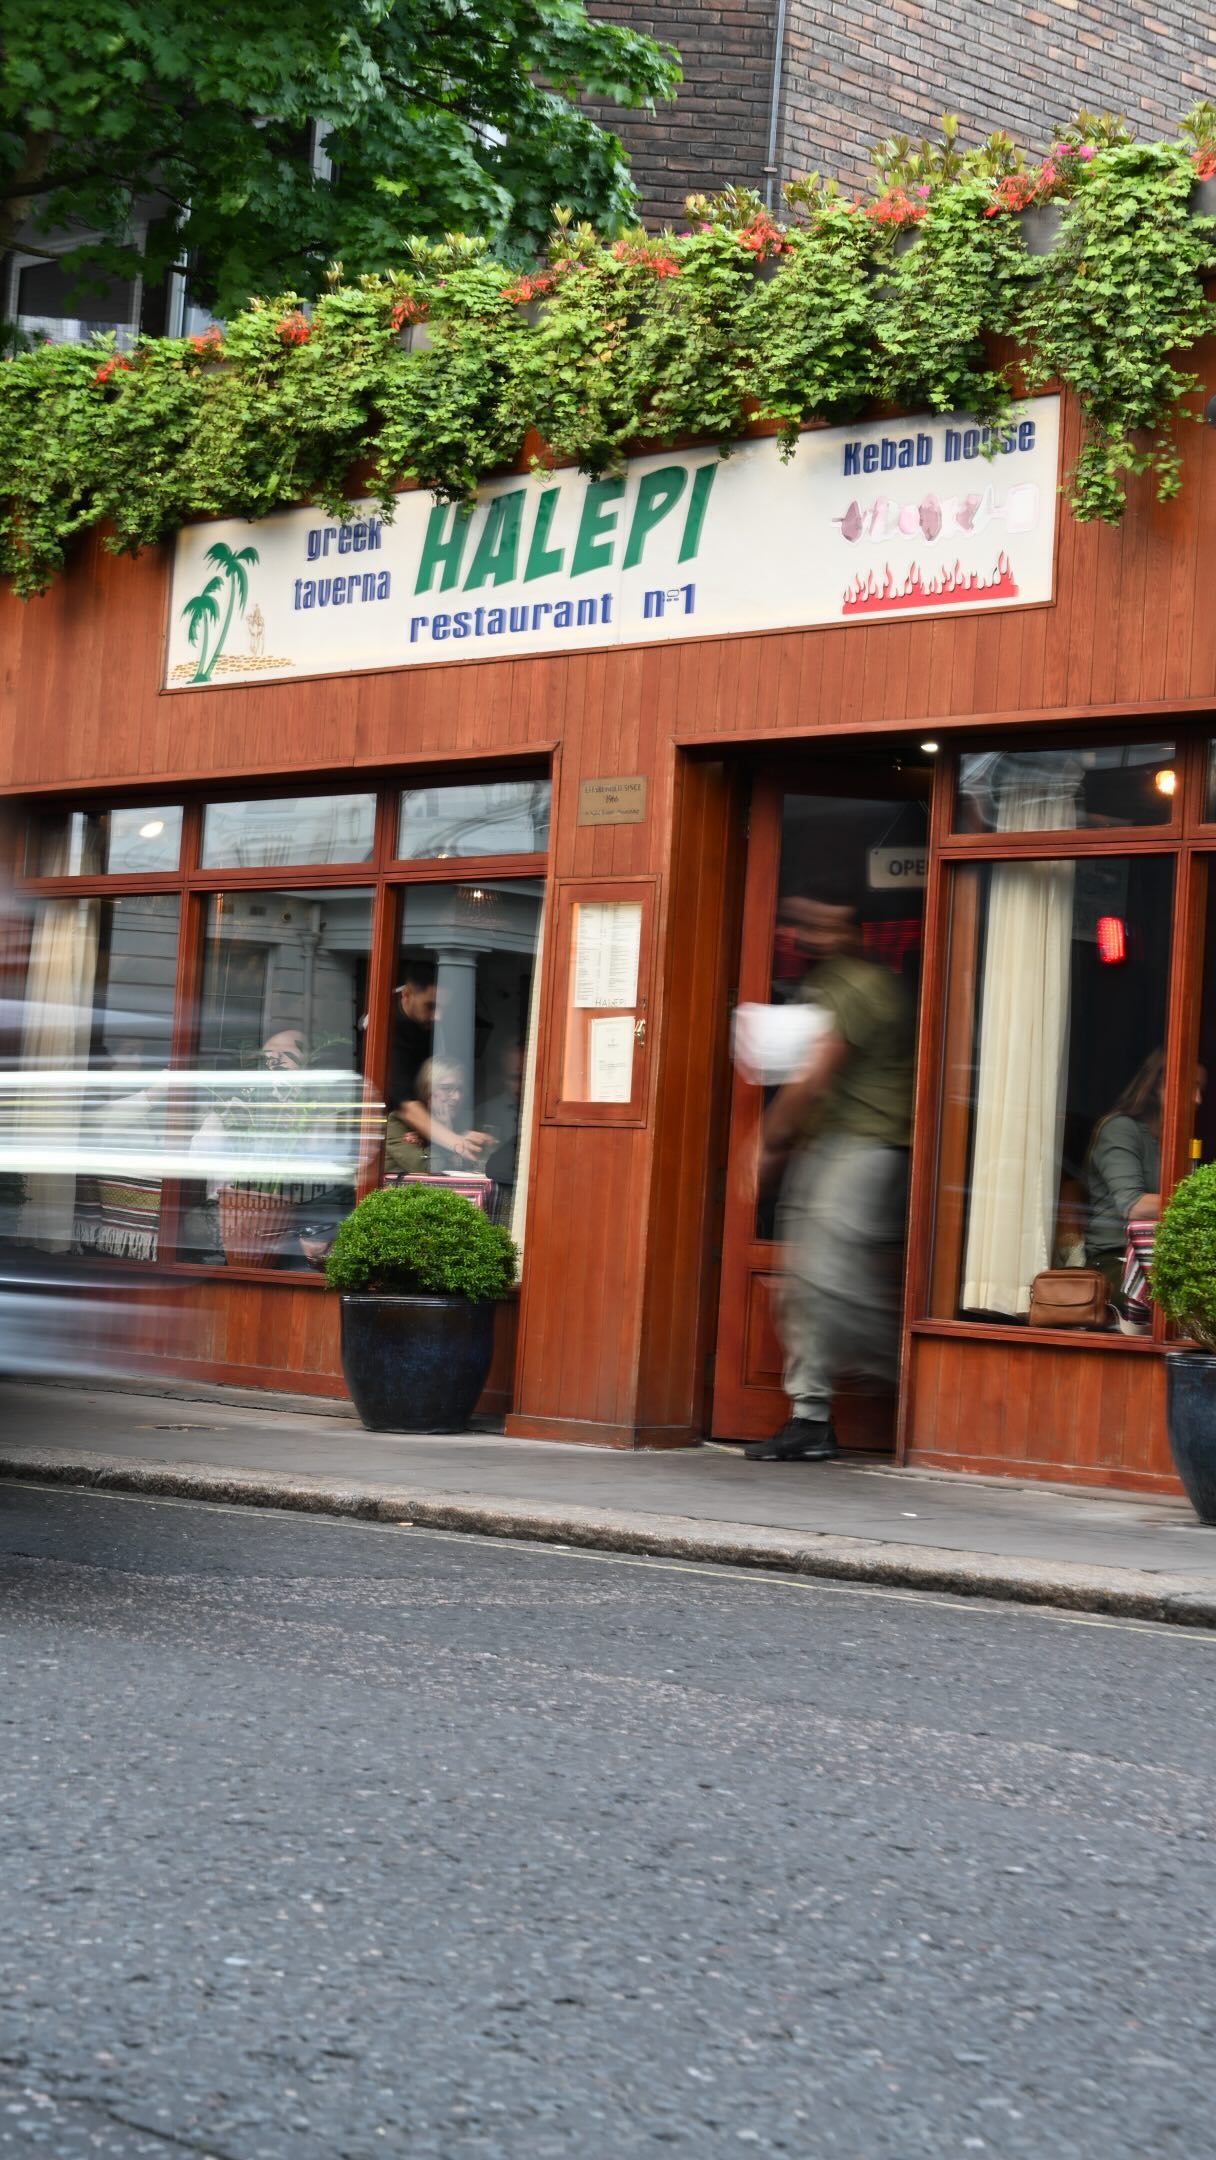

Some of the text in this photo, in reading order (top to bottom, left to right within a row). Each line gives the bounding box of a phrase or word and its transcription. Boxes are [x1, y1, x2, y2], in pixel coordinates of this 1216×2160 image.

[843, 432, 933, 477] Kebab
[306, 517, 384, 562] greek
[413, 462, 719, 597] HALEPI
[294, 570, 392, 611] taverna
[409, 592, 614, 643] restaurant
[889, 859, 928, 877] OPE
